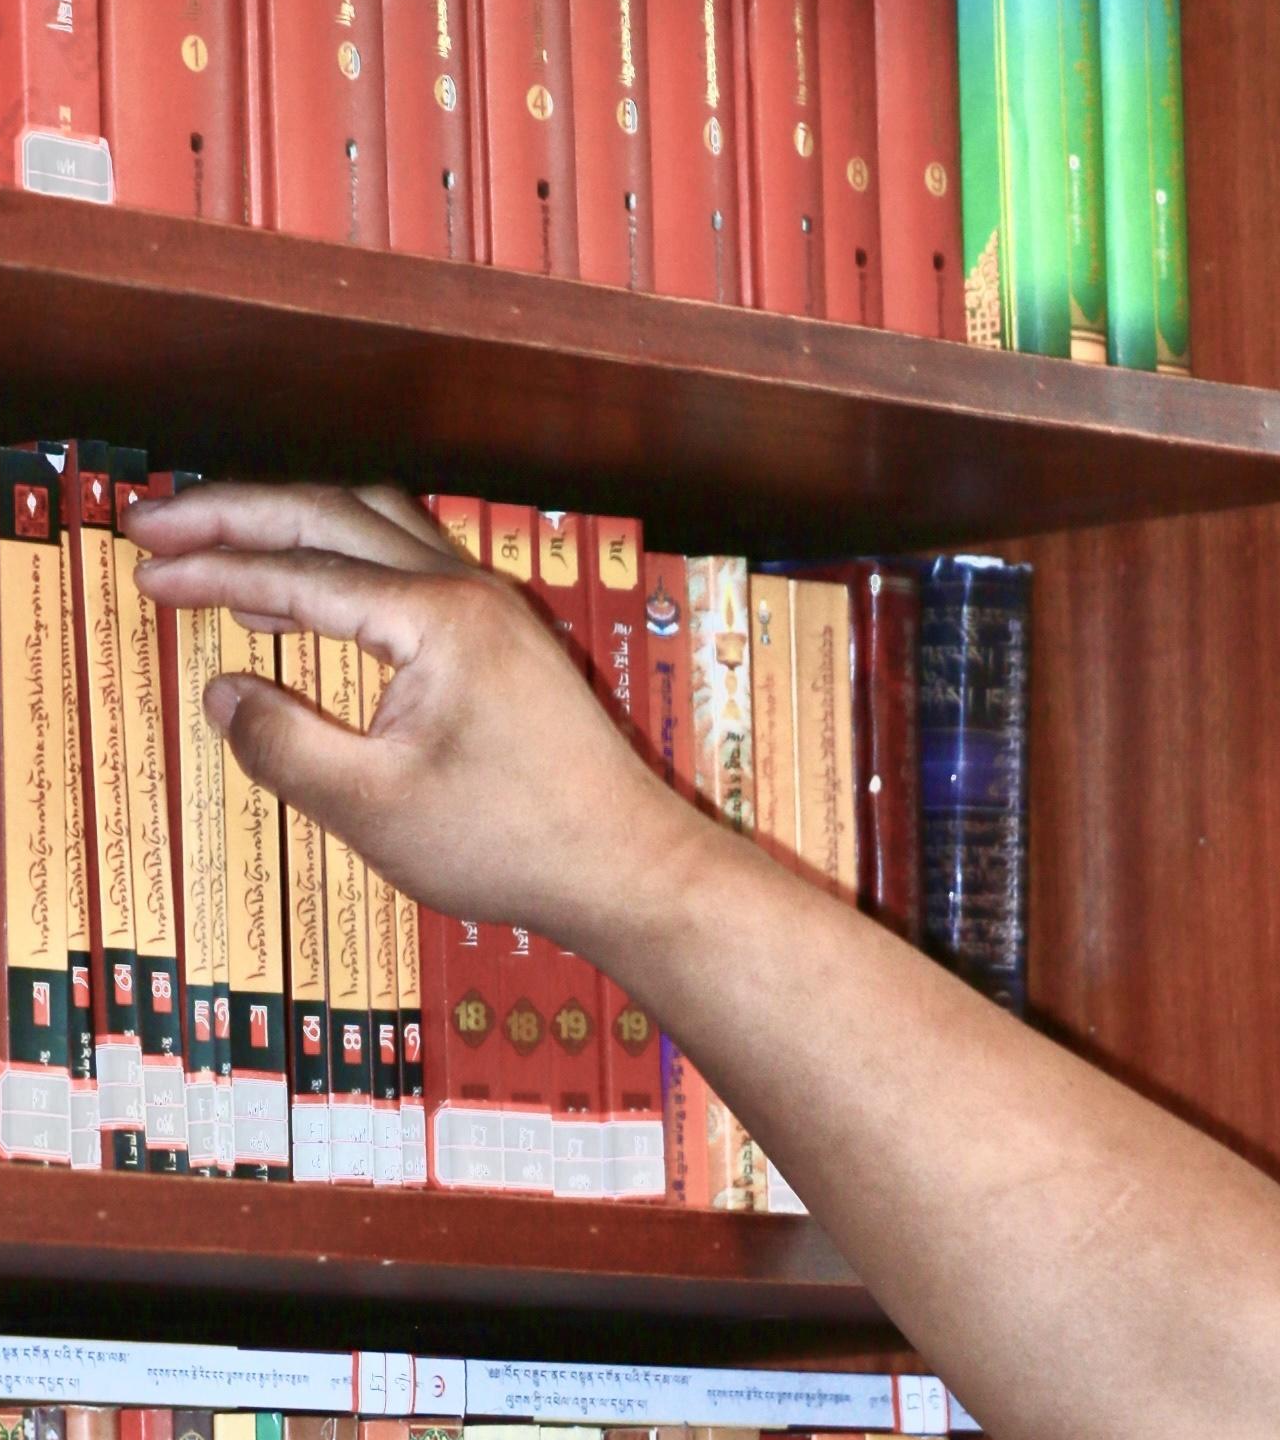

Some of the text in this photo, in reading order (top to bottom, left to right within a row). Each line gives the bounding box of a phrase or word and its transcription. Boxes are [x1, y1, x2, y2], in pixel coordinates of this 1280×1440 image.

[455, 1000, 487, 1031] 18
[507, 1010, 539, 1043] 18
[555, 1007, 588, 1040] 19
[617, 1009, 649, 1041] 19
